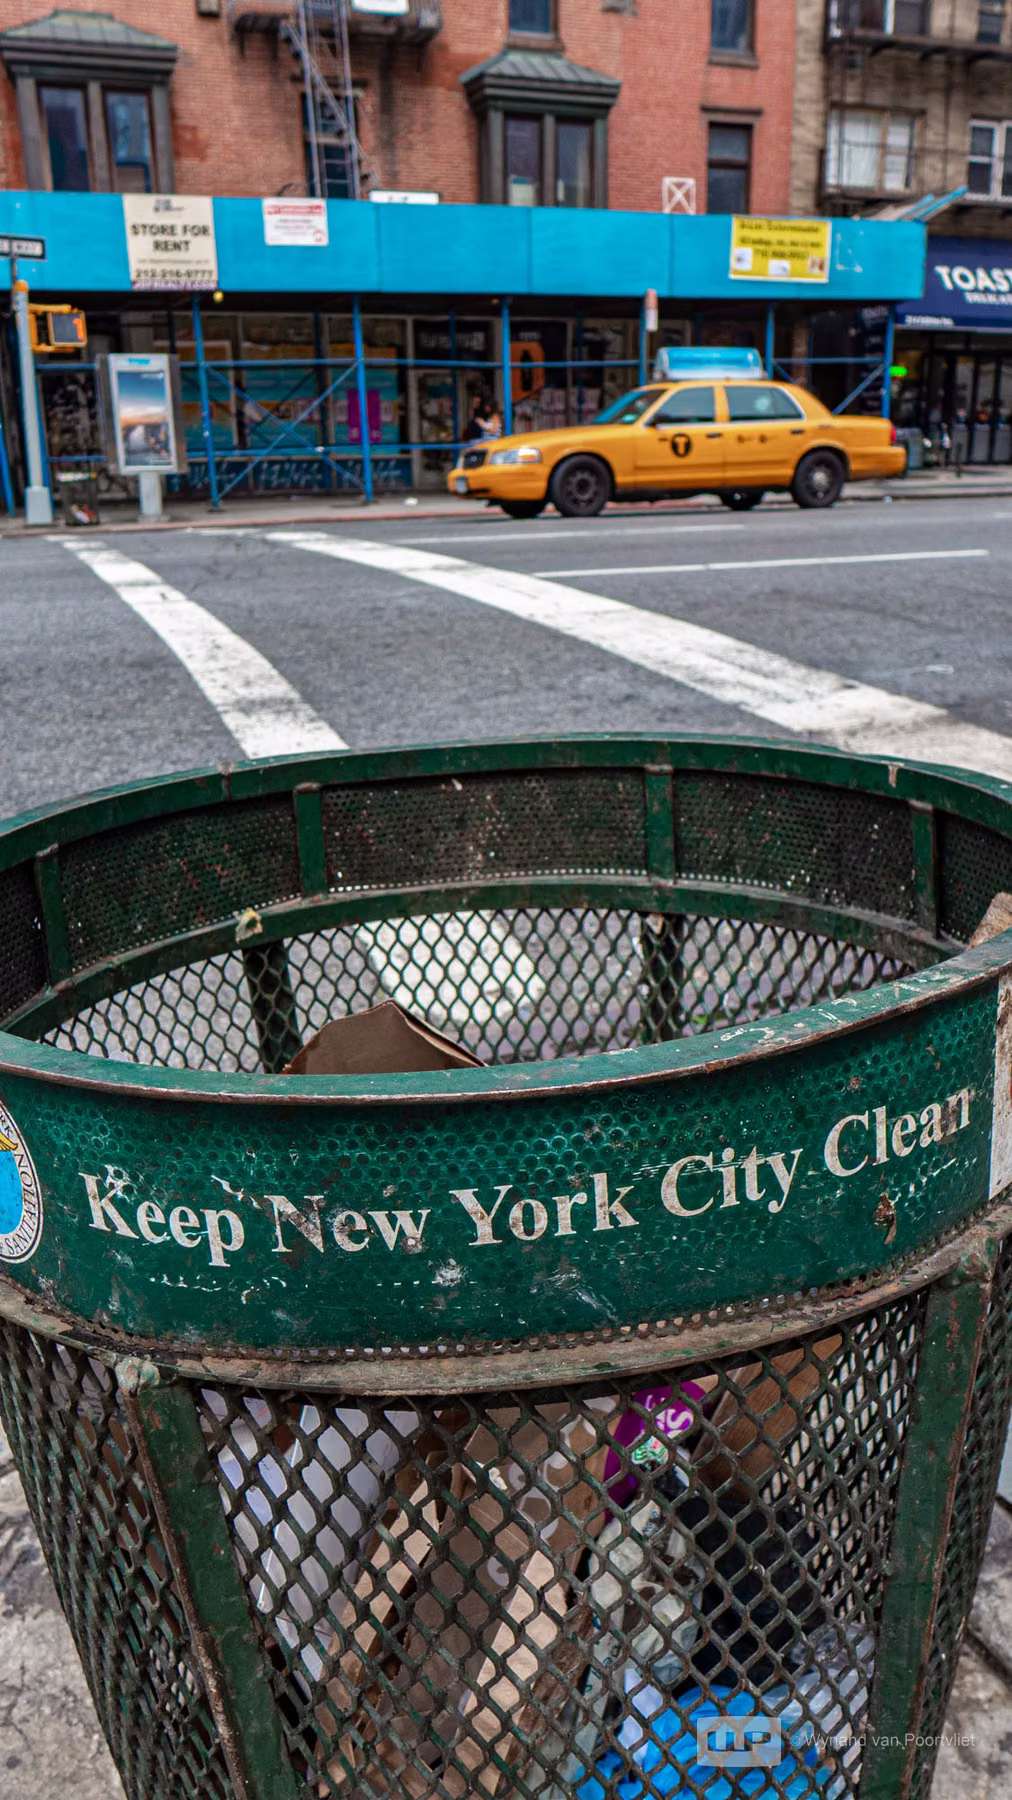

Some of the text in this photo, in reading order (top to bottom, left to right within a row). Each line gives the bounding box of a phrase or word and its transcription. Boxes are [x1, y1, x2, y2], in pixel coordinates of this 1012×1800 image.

[131, 223, 211, 236] STORE FOR
[153, 240, 192, 252] RENT
[5, 1153, 36, 1256] SANITATION
[78, 1087, 975, 1268] Keep New York City Clean
